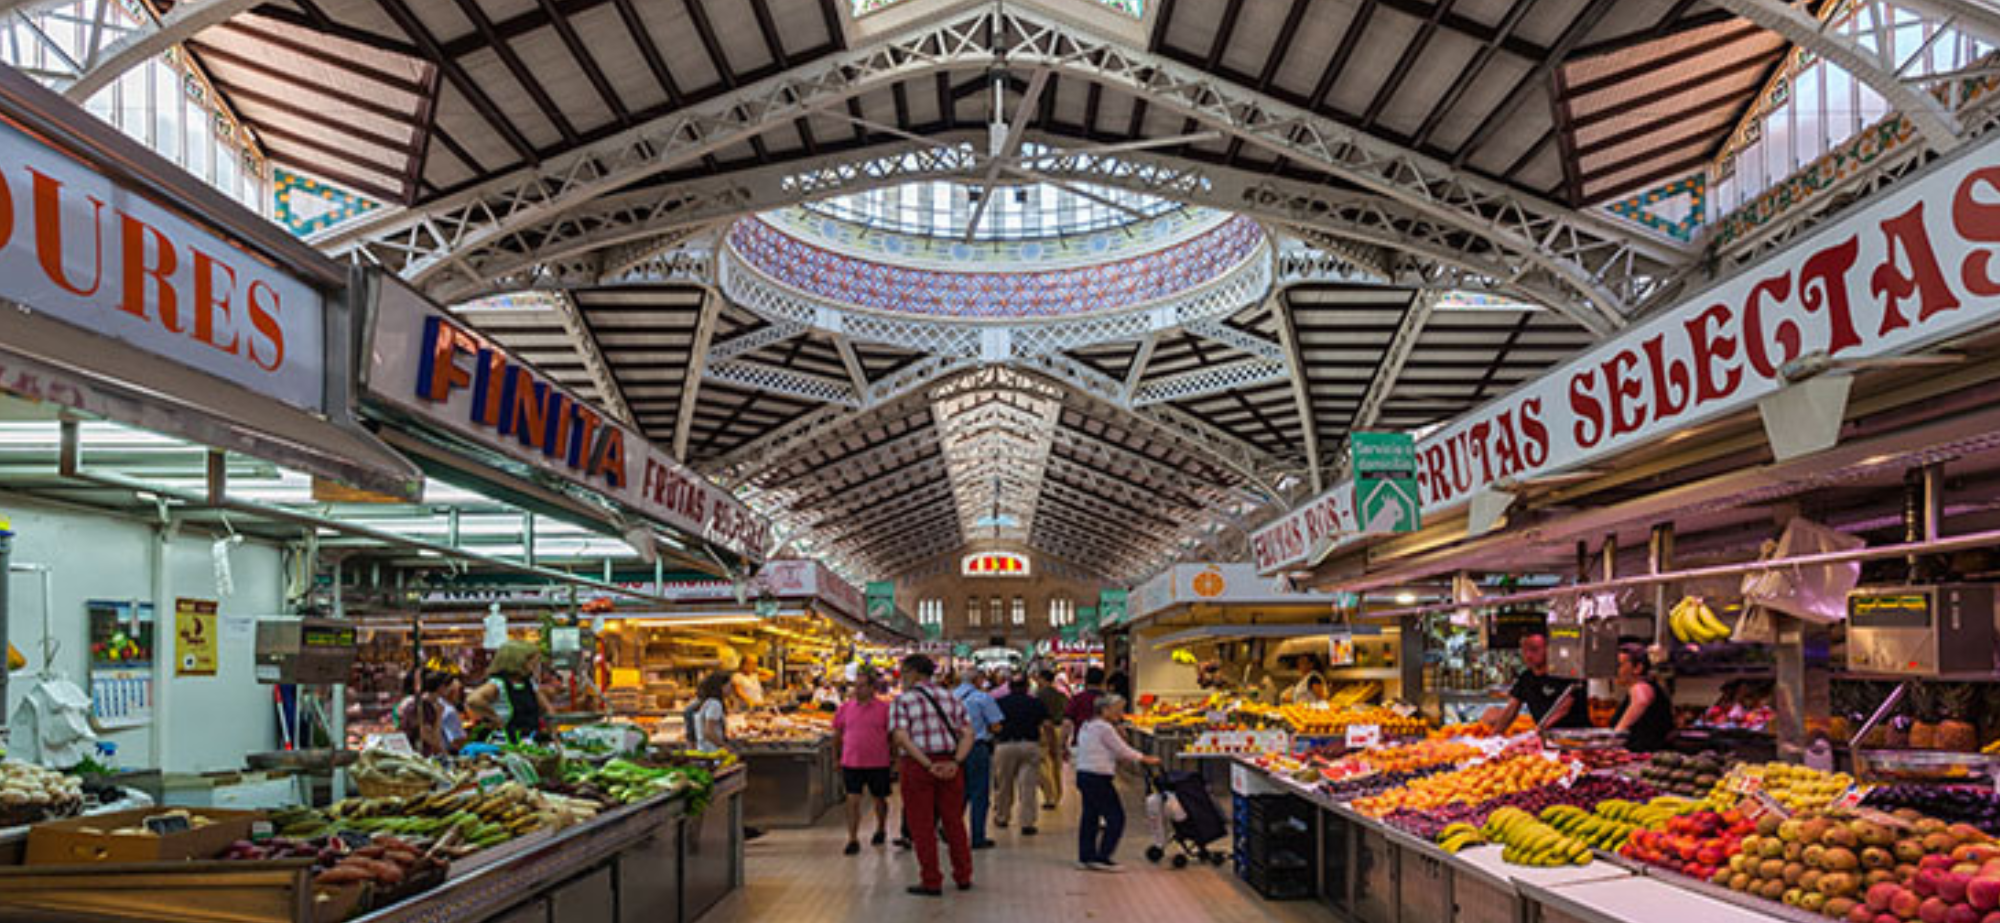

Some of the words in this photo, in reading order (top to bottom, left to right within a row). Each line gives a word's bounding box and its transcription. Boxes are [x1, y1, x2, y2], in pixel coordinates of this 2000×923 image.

[416, 315, 627, 489] FINITA
[1416, 397, 1549, 507] FRUTAS
[1569, 166, 2000, 449] SELECTAS
[642, 457, 706, 524] FRUTAS
